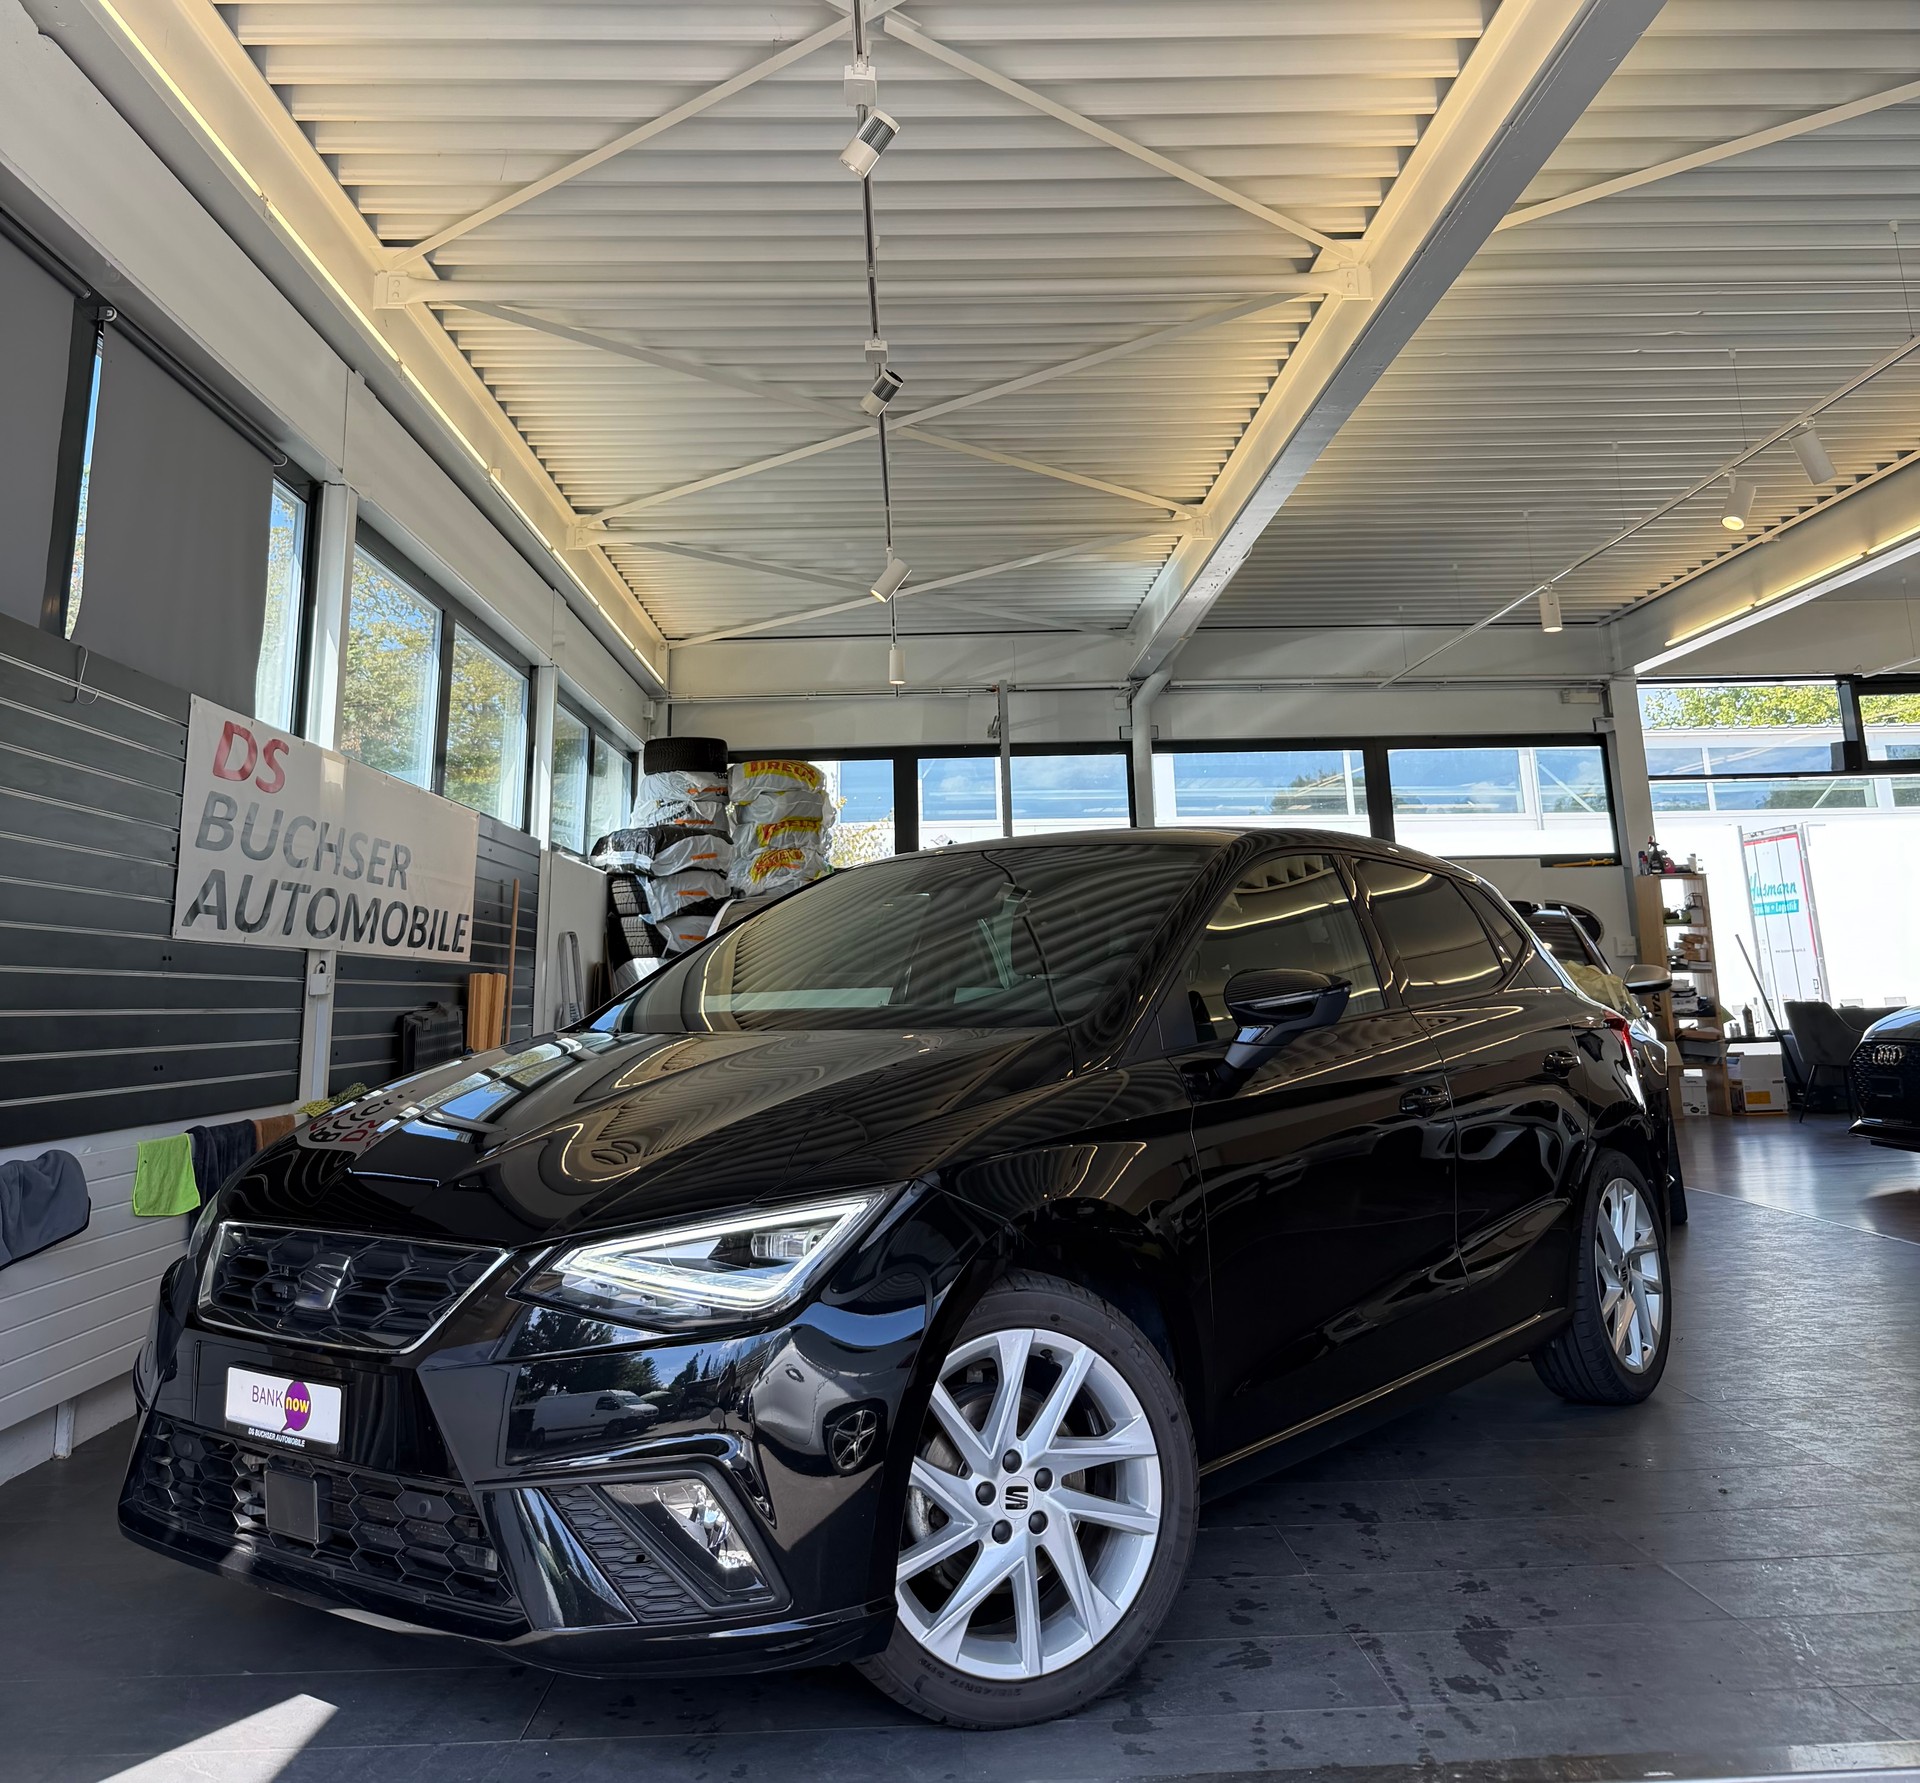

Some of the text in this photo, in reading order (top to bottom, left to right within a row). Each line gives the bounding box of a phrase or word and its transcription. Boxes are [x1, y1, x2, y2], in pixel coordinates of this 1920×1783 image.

[212, 720, 290, 794] DS
[194, 790, 412, 891] BUCHSER
[181, 868, 470, 953] AUTOMOBILE
[252, 1385, 310, 1413] BANK now
[248, 1427, 305, 1447] DS BUCHSER AUTOMOBILE
